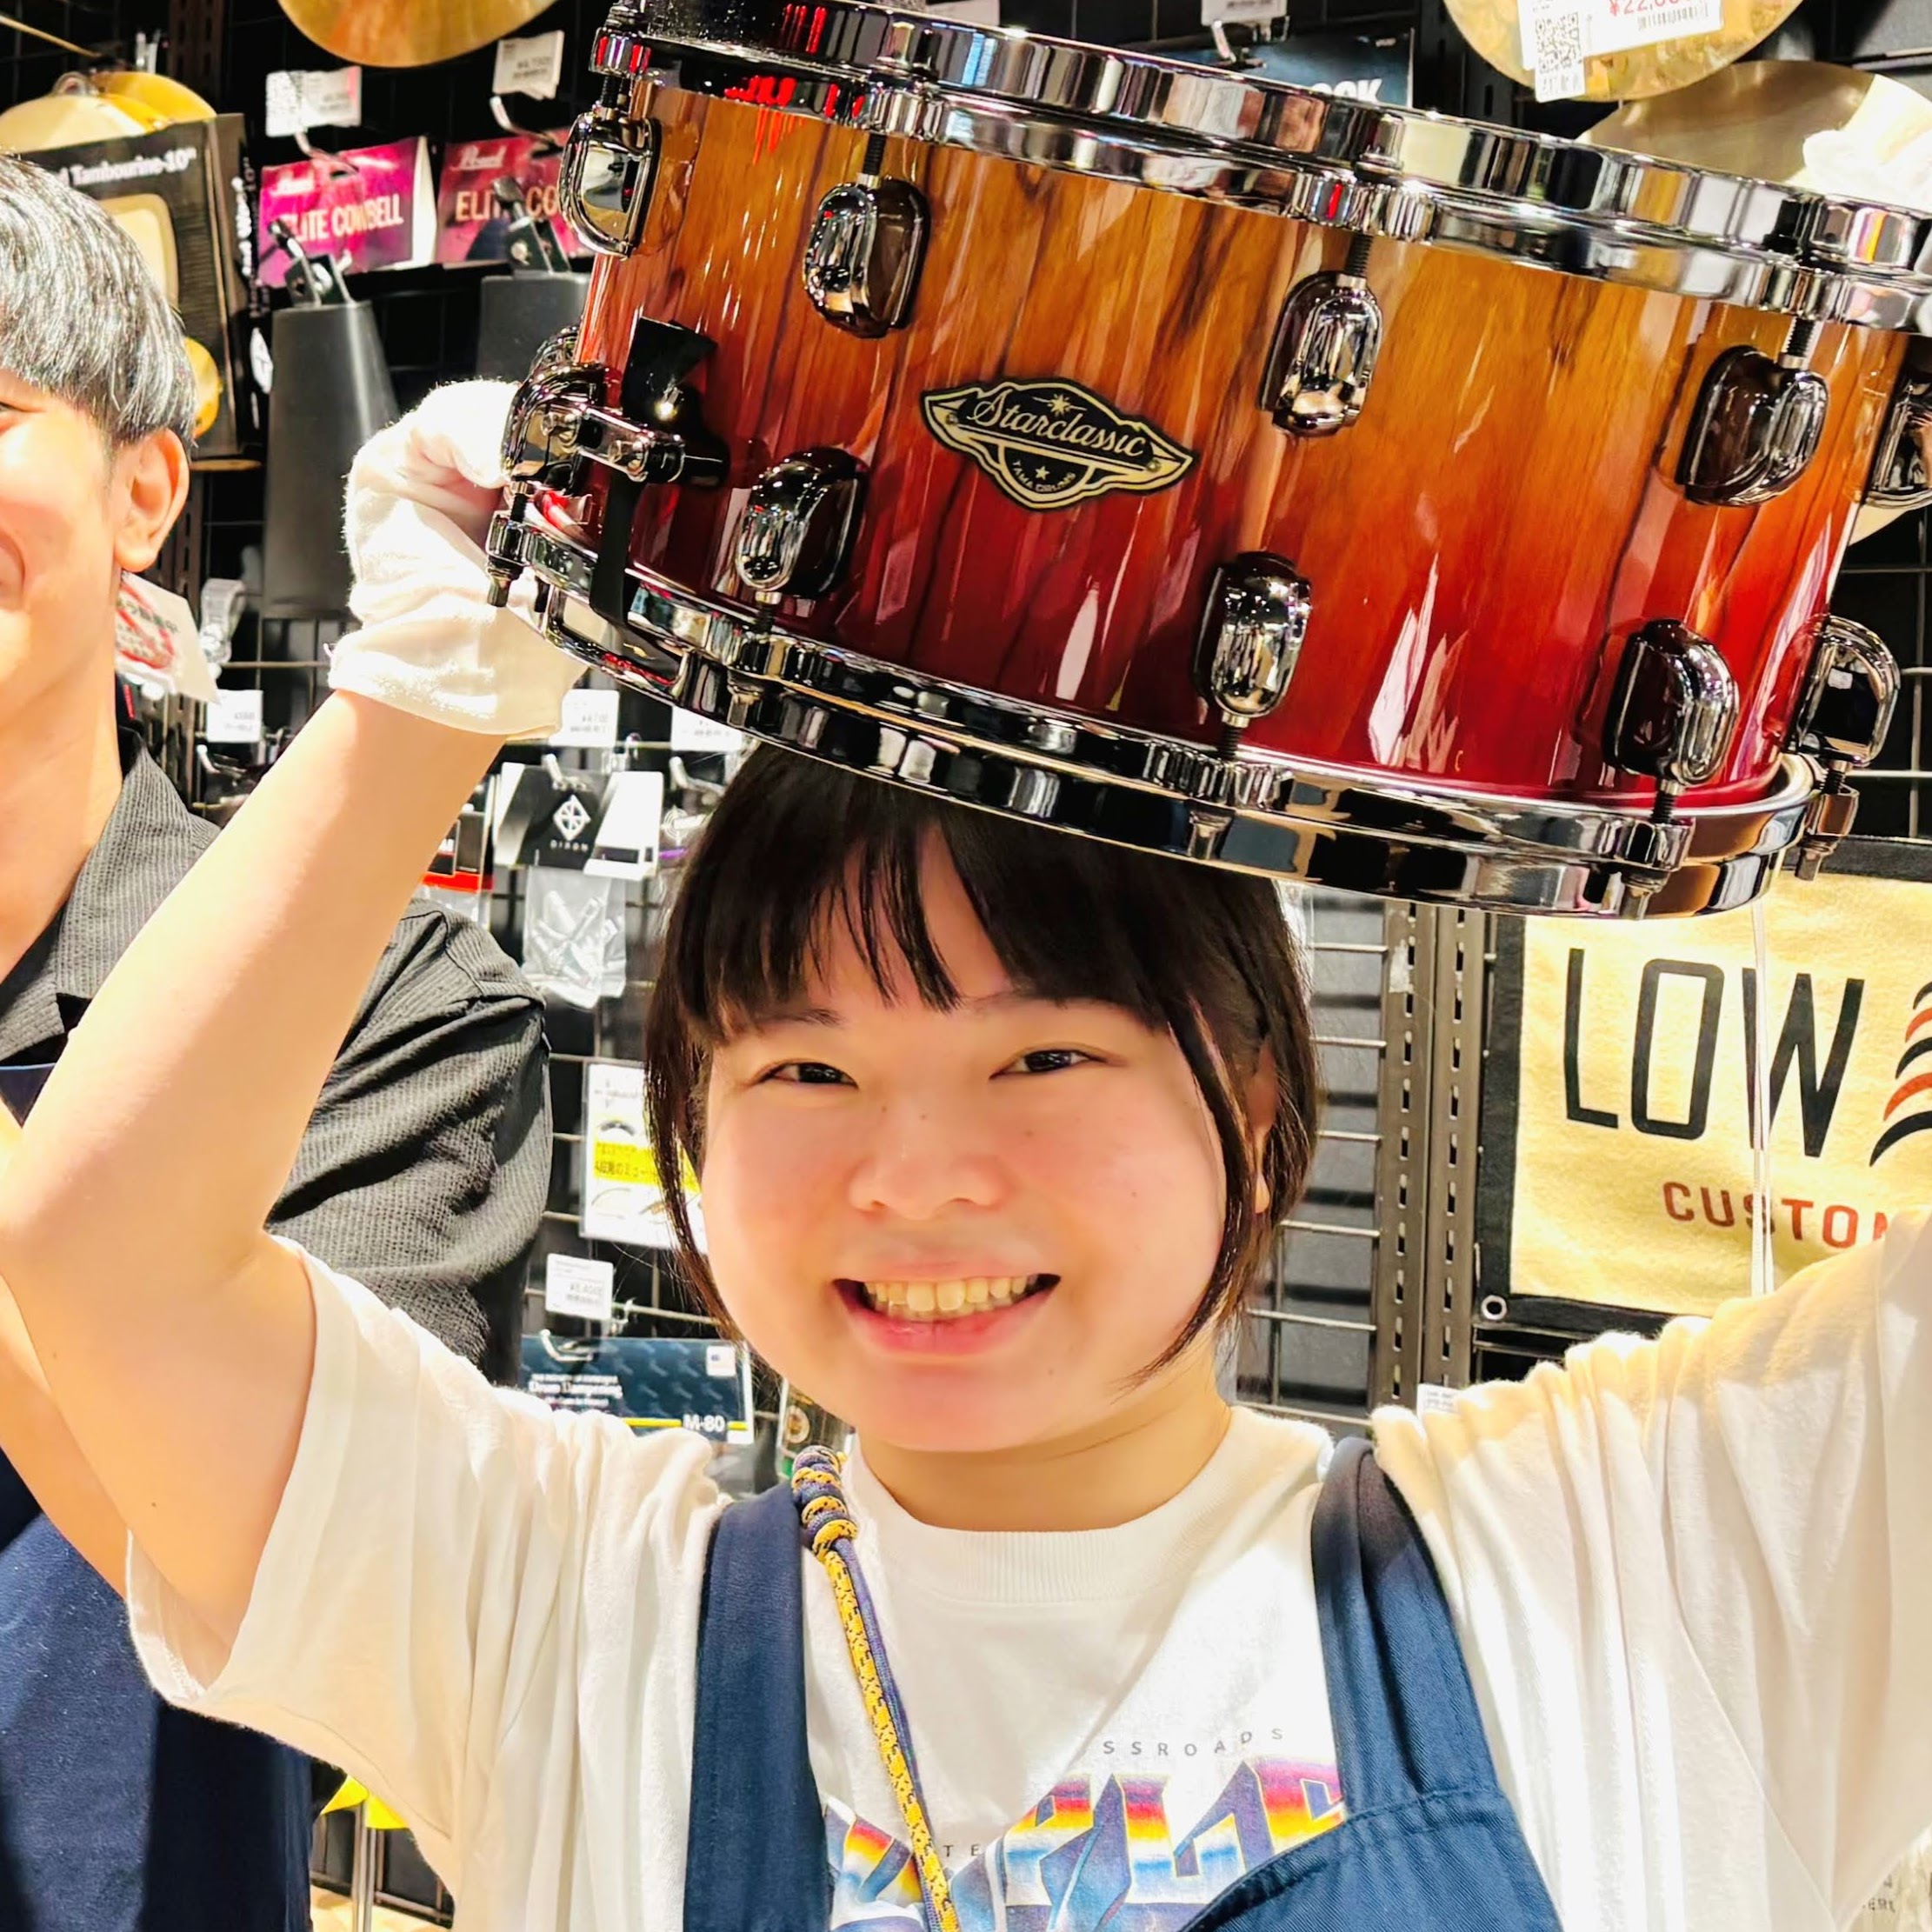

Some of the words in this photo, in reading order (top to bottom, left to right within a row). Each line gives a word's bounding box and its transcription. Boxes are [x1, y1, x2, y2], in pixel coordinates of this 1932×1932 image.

[967, 390, 1146, 457] Starclassic
[1563, 947, 1866, 1158] LOW
[683, 1413, 725, 1433] M-80
